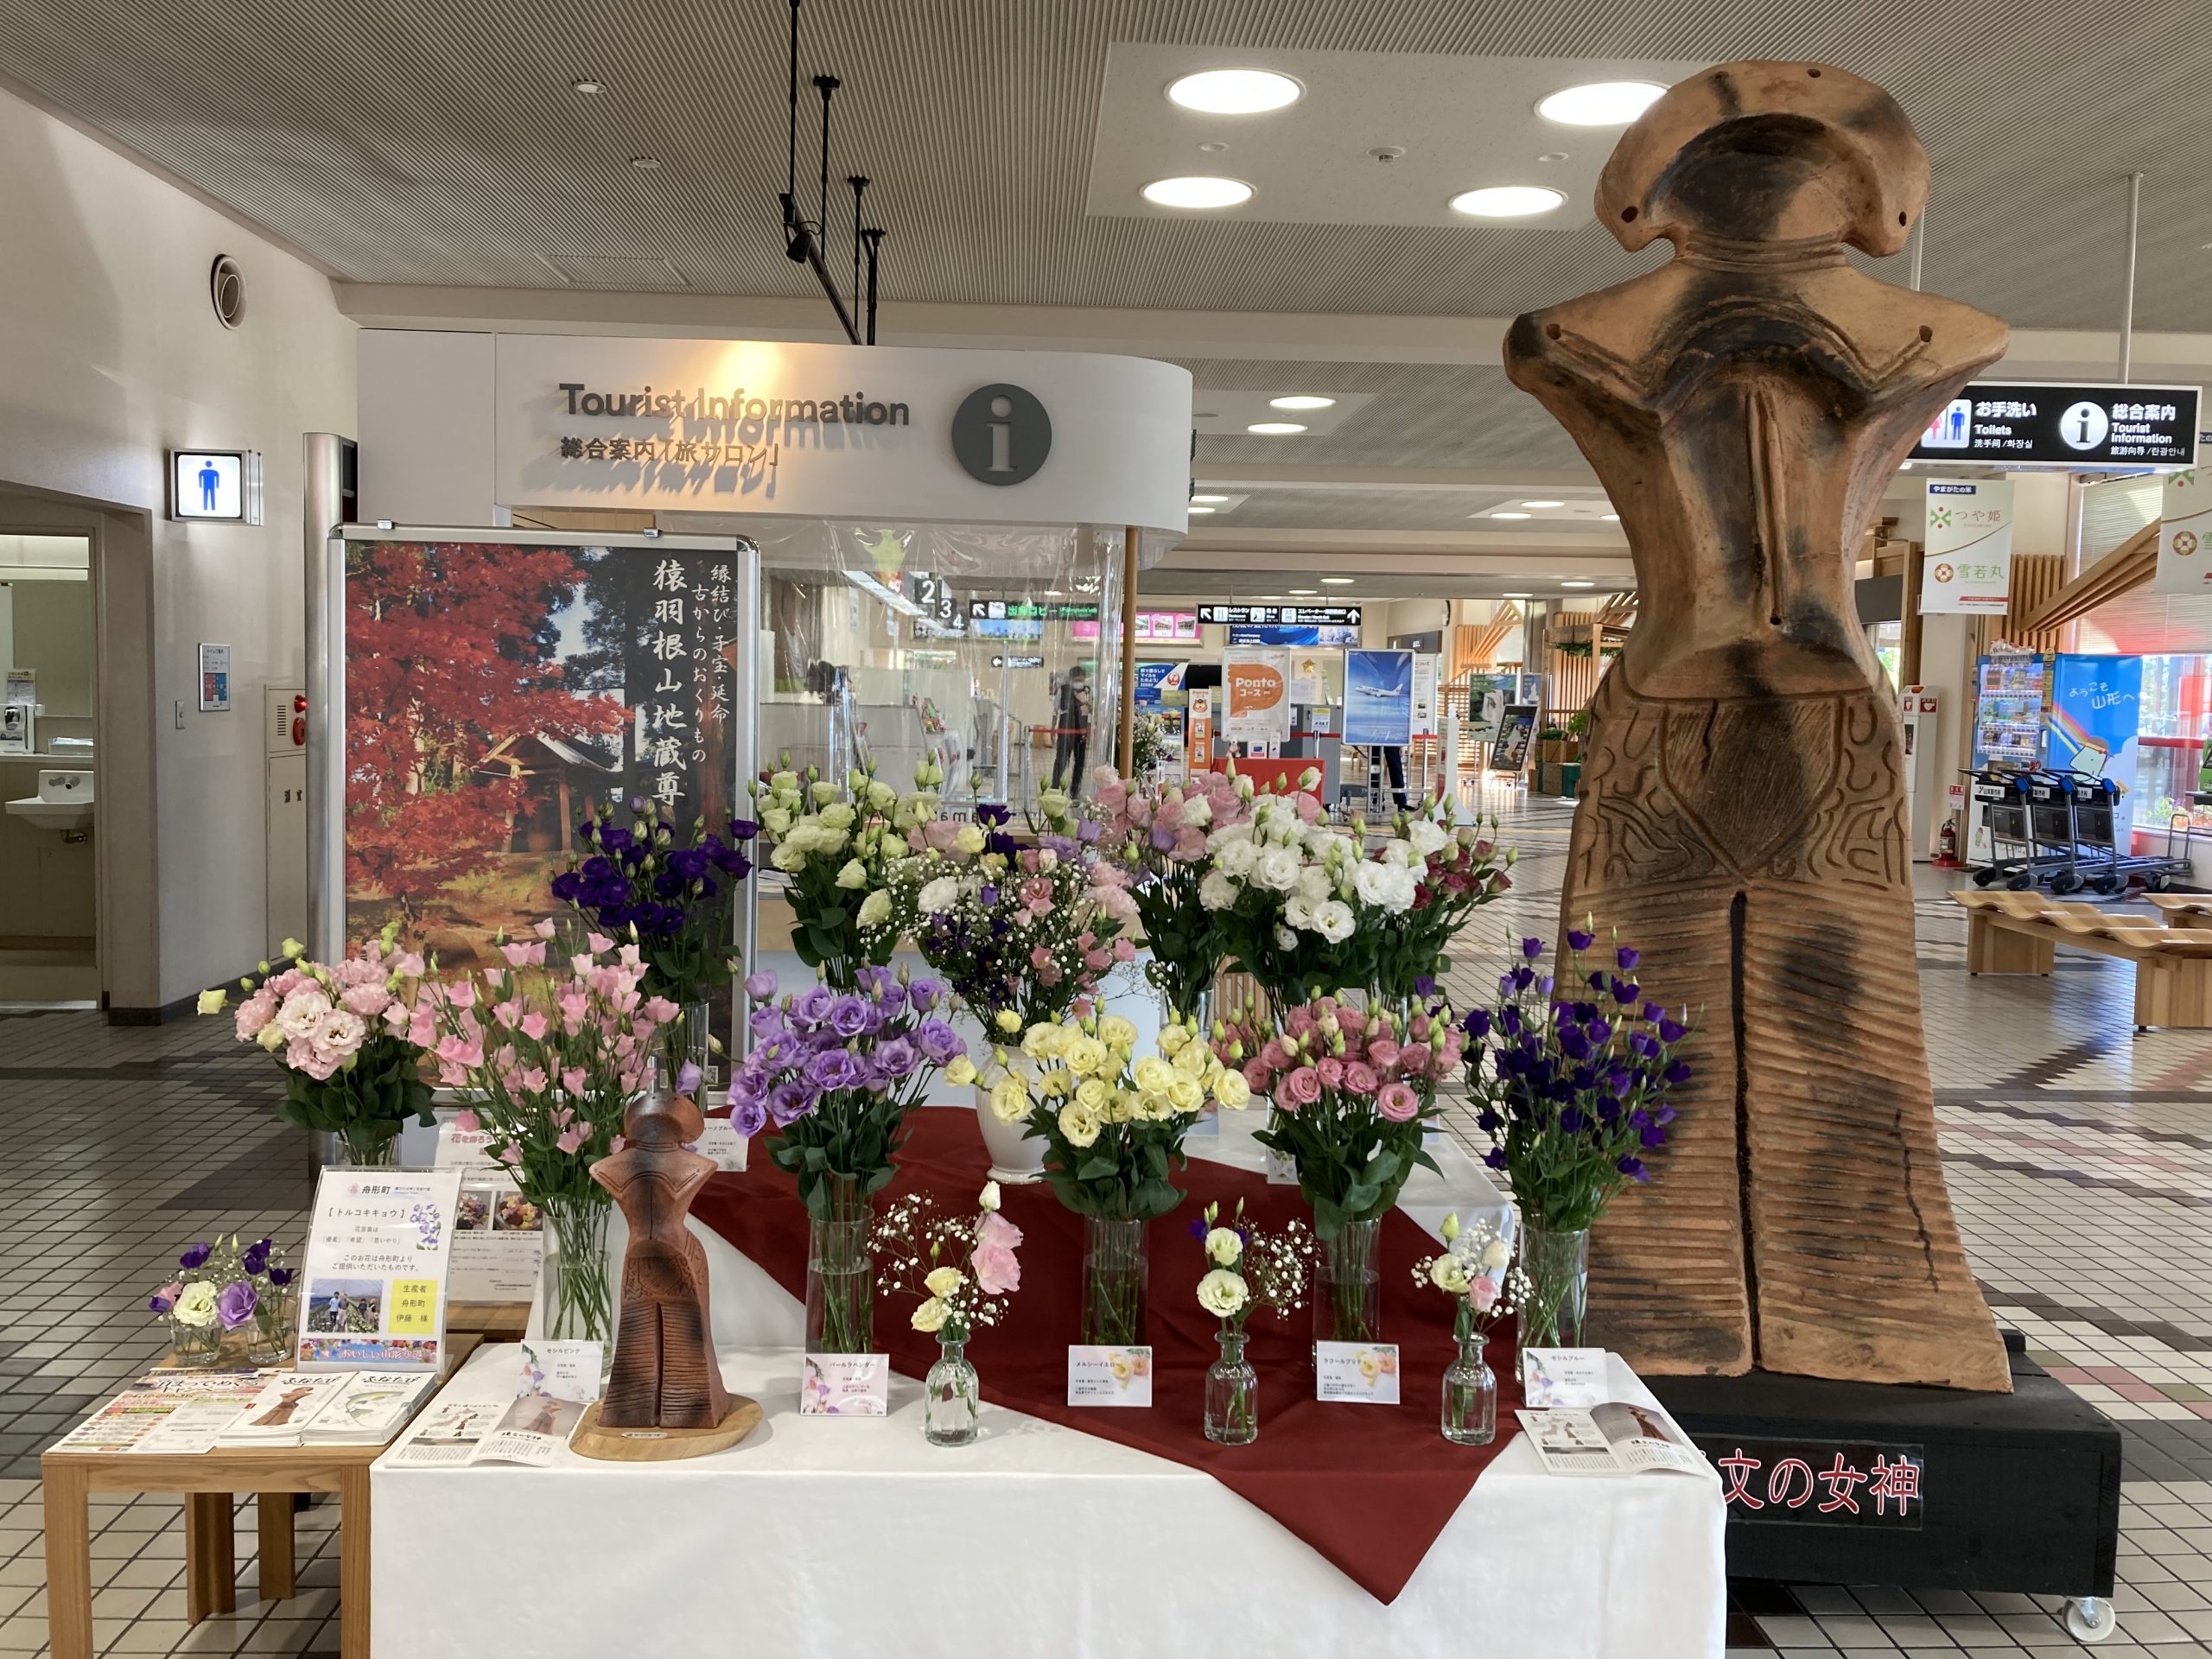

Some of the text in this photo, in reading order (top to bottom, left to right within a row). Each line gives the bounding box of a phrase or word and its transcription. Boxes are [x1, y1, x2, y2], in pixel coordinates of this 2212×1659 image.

[559, 384, 910, 425] Tourist Information
[1975, 401, 2037, 418] お手洗い
[2112, 404, 2176, 422] 総合案内
[1974, 424, 2012, 435] Toilets
[2111, 422, 2151, 434] Tourist
[2111, 432, 2173, 445] Information
[561, 435, 779, 466] 総合案内「旅サロン」
[1955, 509, 2001, 522] つや姫
[1956, 563, 2005, 580] 雪若丸
[921, 580, 936, 604] 2
[939, 600, 952, 619] 3
[952, 613, 964, 629] 4
[691, 583, 709, 763] 古からのおくりもの
[652, 559, 689, 807] 猿羽根山地蔵尊
[1235, 677, 1276, 688] Ponta
[1239, 689, 1262, 697] コース
[2069, 682, 2109, 697] ようこそ
[2091, 691, 2135, 709] 山形へ
[362, 1185, 391, 1194] 舟形町
[328, 1207, 405, 1218] 【トルコキキョウ】
[332, 1262, 419, 1272] ご提供いただいたものです。
[403, 1284, 427, 1294] 生産者
[402, 1299, 426, 1307] 舟形町
[396, 1313, 429, 1323] 伊藤 様
[282, 1376, 343, 1385] ふなたび
[362, 1376, 422, 1384] ふなたび
[1700, 1447, 1921, 1516] 文の女神
